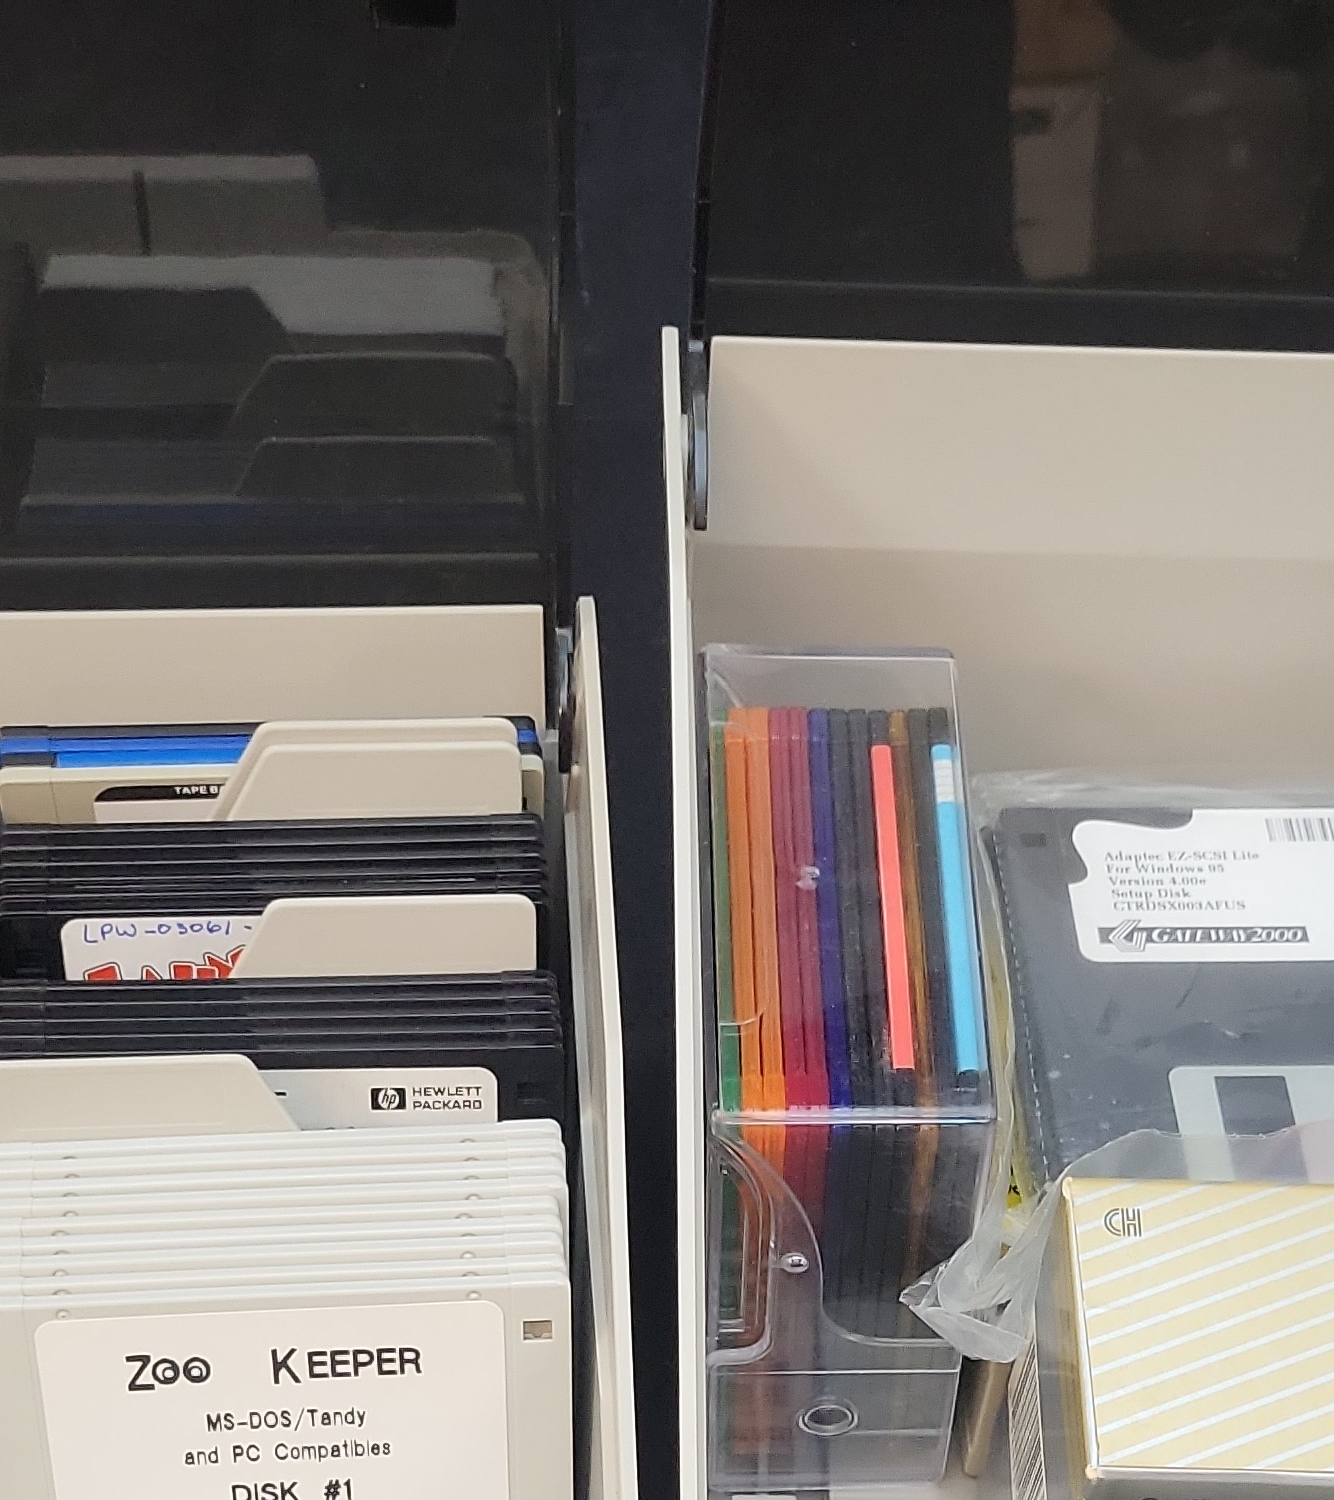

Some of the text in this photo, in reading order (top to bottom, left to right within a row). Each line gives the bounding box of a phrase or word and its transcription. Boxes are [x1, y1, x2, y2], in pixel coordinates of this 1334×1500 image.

[1105, 851, 1163, 864] Adaptec
[1167, 851, 1227, 861] EZ-SCSI
[1107, 864, 1130, 874] For
[1135, 863, 1204, 874] Windows
[1108, 877, 1164, 886] Version
[1111, 888, 1191, 901] Setup Disk
[412, 1086, 482, 1097] HEWLETT
[412, 1100, 482, 1110] PACKARD
[271, 1346, 423, 1386] KEEPER
[206, 1406, 367, 1433] MS-DOS/Tandy
[184, 1439, 392, 1466] and PC Compatibles
